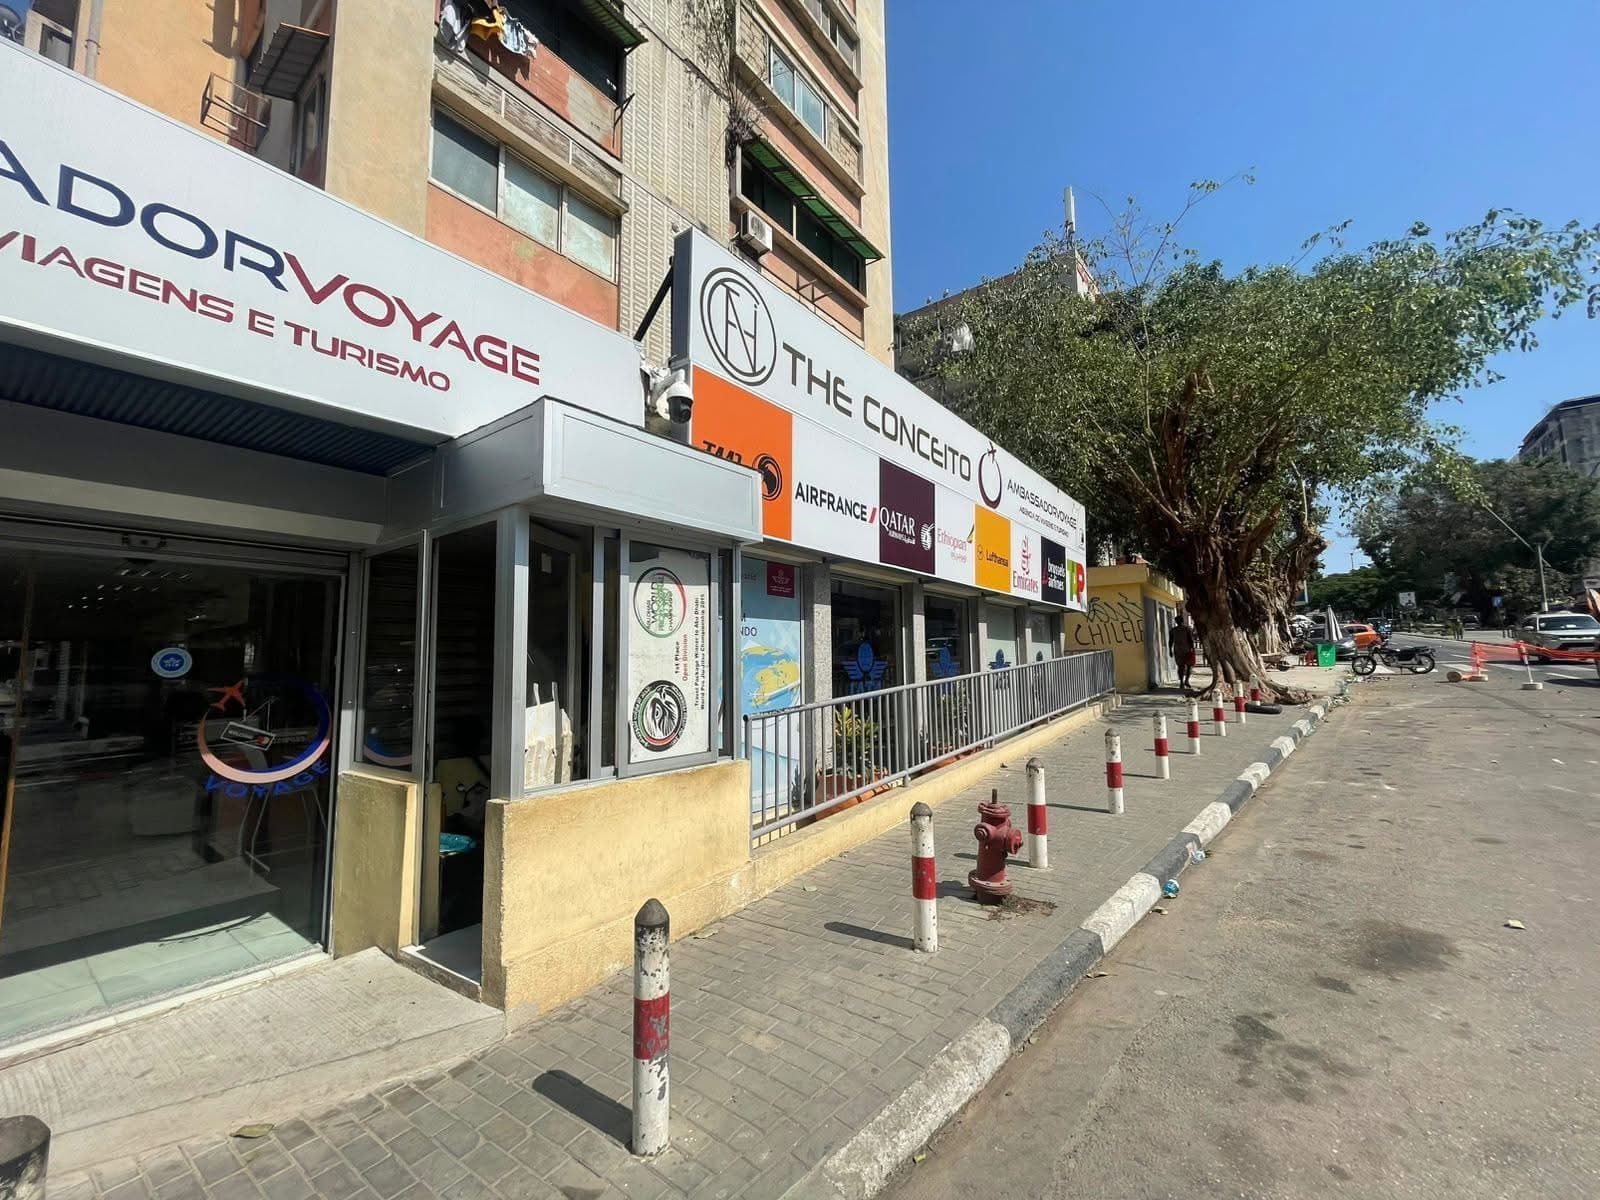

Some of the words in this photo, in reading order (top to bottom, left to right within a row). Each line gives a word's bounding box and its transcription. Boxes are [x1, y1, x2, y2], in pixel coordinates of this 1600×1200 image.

[247, 308, 275, 337] E
[283, 319, 451, 392] TURISMO
[782, 341, 852, 418] THE
[863, 394, 971, 482] CONCEITO
[795, 481, 868, 523] AIRFRANCE
[880, 506, 916, 537] QATAR
[1012, 570, 1039, 593] Emirates
[205, 762, 329, 798] VOYAGE
